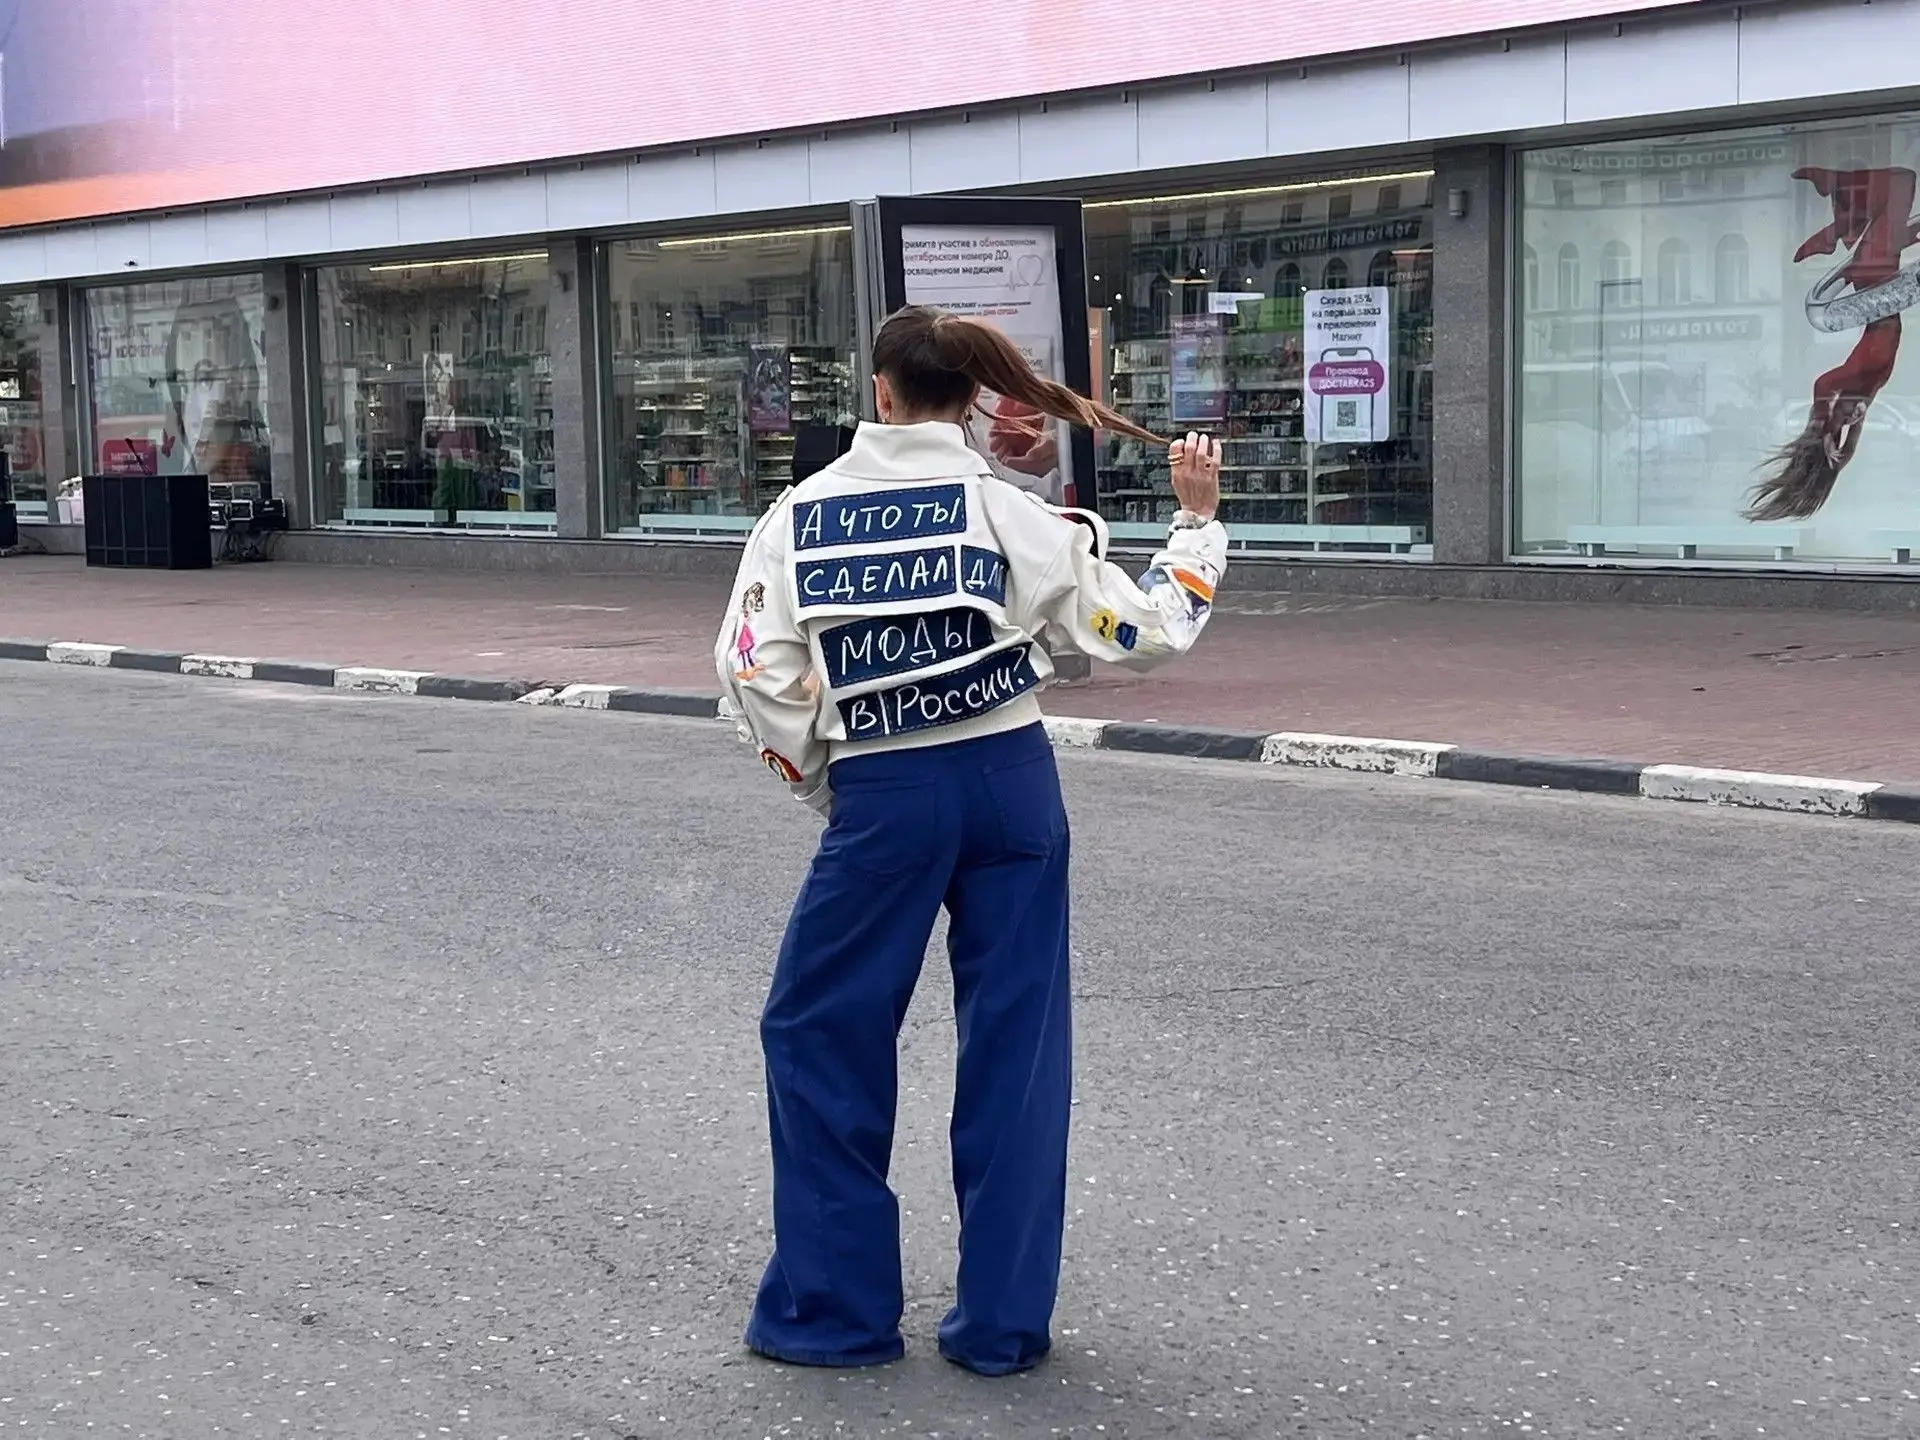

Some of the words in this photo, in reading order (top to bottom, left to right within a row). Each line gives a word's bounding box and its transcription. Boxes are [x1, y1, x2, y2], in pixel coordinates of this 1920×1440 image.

[903, 239, 936, 251] римите
[1320, 296, 1352, 305] Скидка
[1332, 332, 1363, 342] Магнит
[1325, 366, 1369, 376] Промокод
[800, 502, 821, 546] А
[839, 505, 902, 537] ЧТО
[911, 496, 961, 529] ТЫ
[803, 554, 950, 600] СДЕЛАЛ
[841, 612, 973, 676] МОДЫ
[851, 700, 878, 730] В
